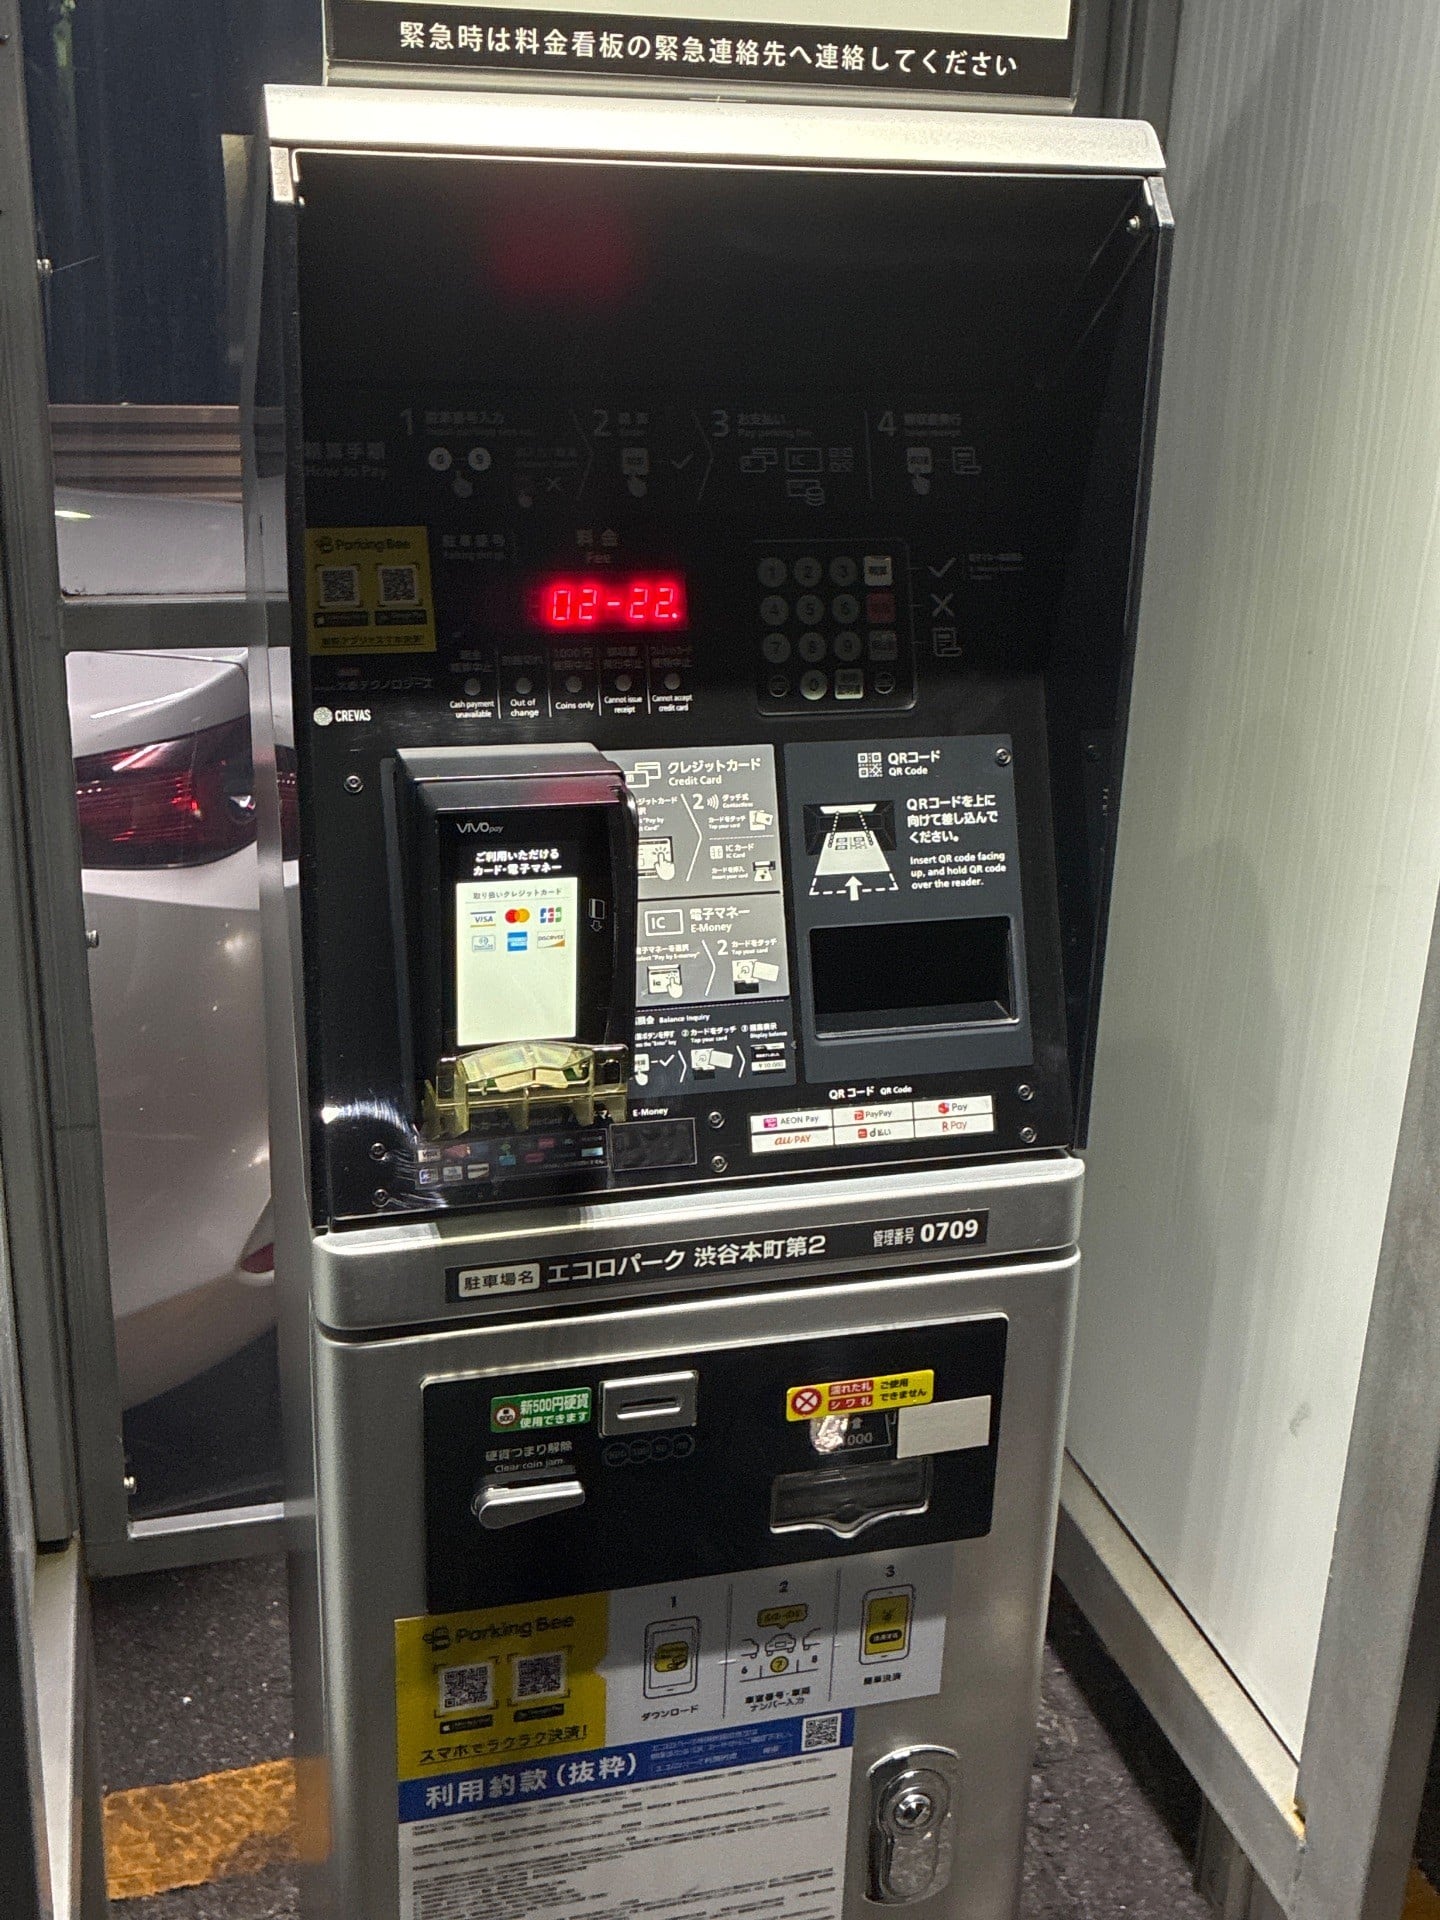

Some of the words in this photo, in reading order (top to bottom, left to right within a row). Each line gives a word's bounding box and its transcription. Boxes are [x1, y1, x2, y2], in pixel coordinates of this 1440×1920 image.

[399, 21, 1018, 78] 緊急時は料金看板の緊急連絡先へ連絡してください
[510, 698, 526, 707] Out
[555, 701, 577, 710] Coins
[577, 701, 595, 711] only
[334, 708, 373, 723] CREVAS
[510, 709, 540, 719] change
[887, 749, 941, 765] QRコード
[667, 757, 762, 775] クレジットカード
[888, 766, 904, 776] QR
[904, 765, 929, 776] Code
[668, 776, 698, 787] Credit
[699, 774, 723, 785] Card
[692, 793, 705, 810] 2
[906, 794, 997, 811] QRコードを上に
[906, 810, 999, 828] 向けて差し込んで
[908, 830, 961, 844] ください。
[474, 848, 560, 863] ご利用いただける
[910, 855, 937, 865] Insert
[938, 854, 953, 864] QR
[953, 853, 977, 863] code
[977, 851, 1006, 863] facing
[472, 862, 563, 877] カード・電子マネー
[911, 869, 927, 879] up,
[927, 867, 947, 877] and
[946, 865, 968, 876] hold
[969, 864, 984, 874] QR
[984, 863, 1007, 873] code
[911, 880, 934, 890] over
[934, 878, 951, 889] the
[951, 877, 985, 888] reader.
[475, 915, 494, 923] VISA
[689, 906, 751, 922] 電子マネー
[650, 917, 666, 930] IC
[690, 923, 733, 933] E-Money
[716, 940, 729, 956] 2
[828, 1088, 845, 1100] QR
[846, 1085, 875, 1098] コード
[880, 1086, 893, 1096] QR
[892, 1084, 913, 1094] Code
[631, 1106, 669, 1117] E-Money
[951, 1102, 969, 1112] Pay
[780, 1115, 804, 1125] AEON
[805, 1114, 819, 1124] Pay
[864, 1109, 893, 1120] PayPay
[950, 1120, 968, 1131] Pay
[794, 1134, 812, 1144] PAY
[872, 1226, 915, 1248] 管理番号
[919, 1218, 980, 1244] 0709
[547, 1248, 687, 1284] エコロパーク
[692, 1234, 827, 1268] 渋谷本町第2
[463, 1270, 535, 1292] 駐車場名
[879, 1378, 909, 1391] ご使用
[880, 1388, 927, 1402] できません
[520, 1393, 590, 1416] 新500円硬貨
[520, 1411, 588, 1429] 使用できます
[494, 1462, 521, 1474] Clear
[885, 1564, 896, 1578] 3
[779, 1580, 789, 1594] 2
[456, 1621, 533, 1644] Parking
[535, 1615, 576, 1632] Bee
[750, 1696, 805, 1712] ナンバー入力
[641, 1704, 699, 1721] ダウンロード
